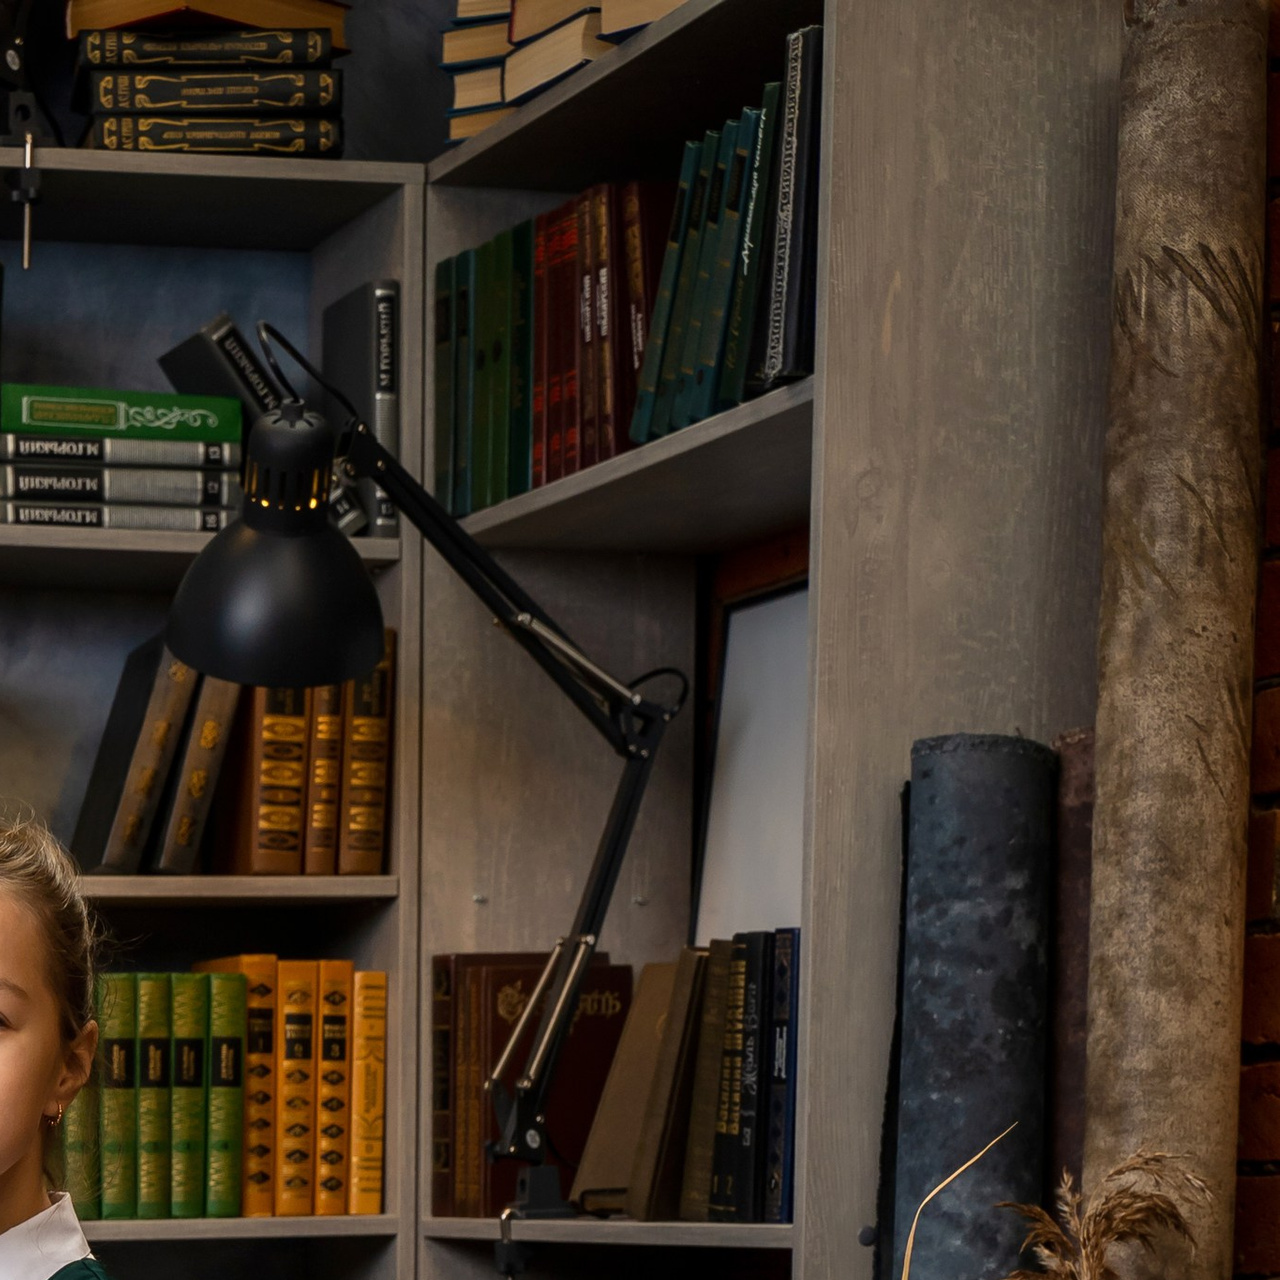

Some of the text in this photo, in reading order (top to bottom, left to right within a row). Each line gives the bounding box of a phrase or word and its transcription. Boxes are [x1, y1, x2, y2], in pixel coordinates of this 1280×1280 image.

[20, 441, 99, 458] М.ГОРЬКИЙ
[19, 475, 98, 492] М.ГОРЬКИЙ
[20, 507, 98, 524] М.ГОРЬКИЙ
